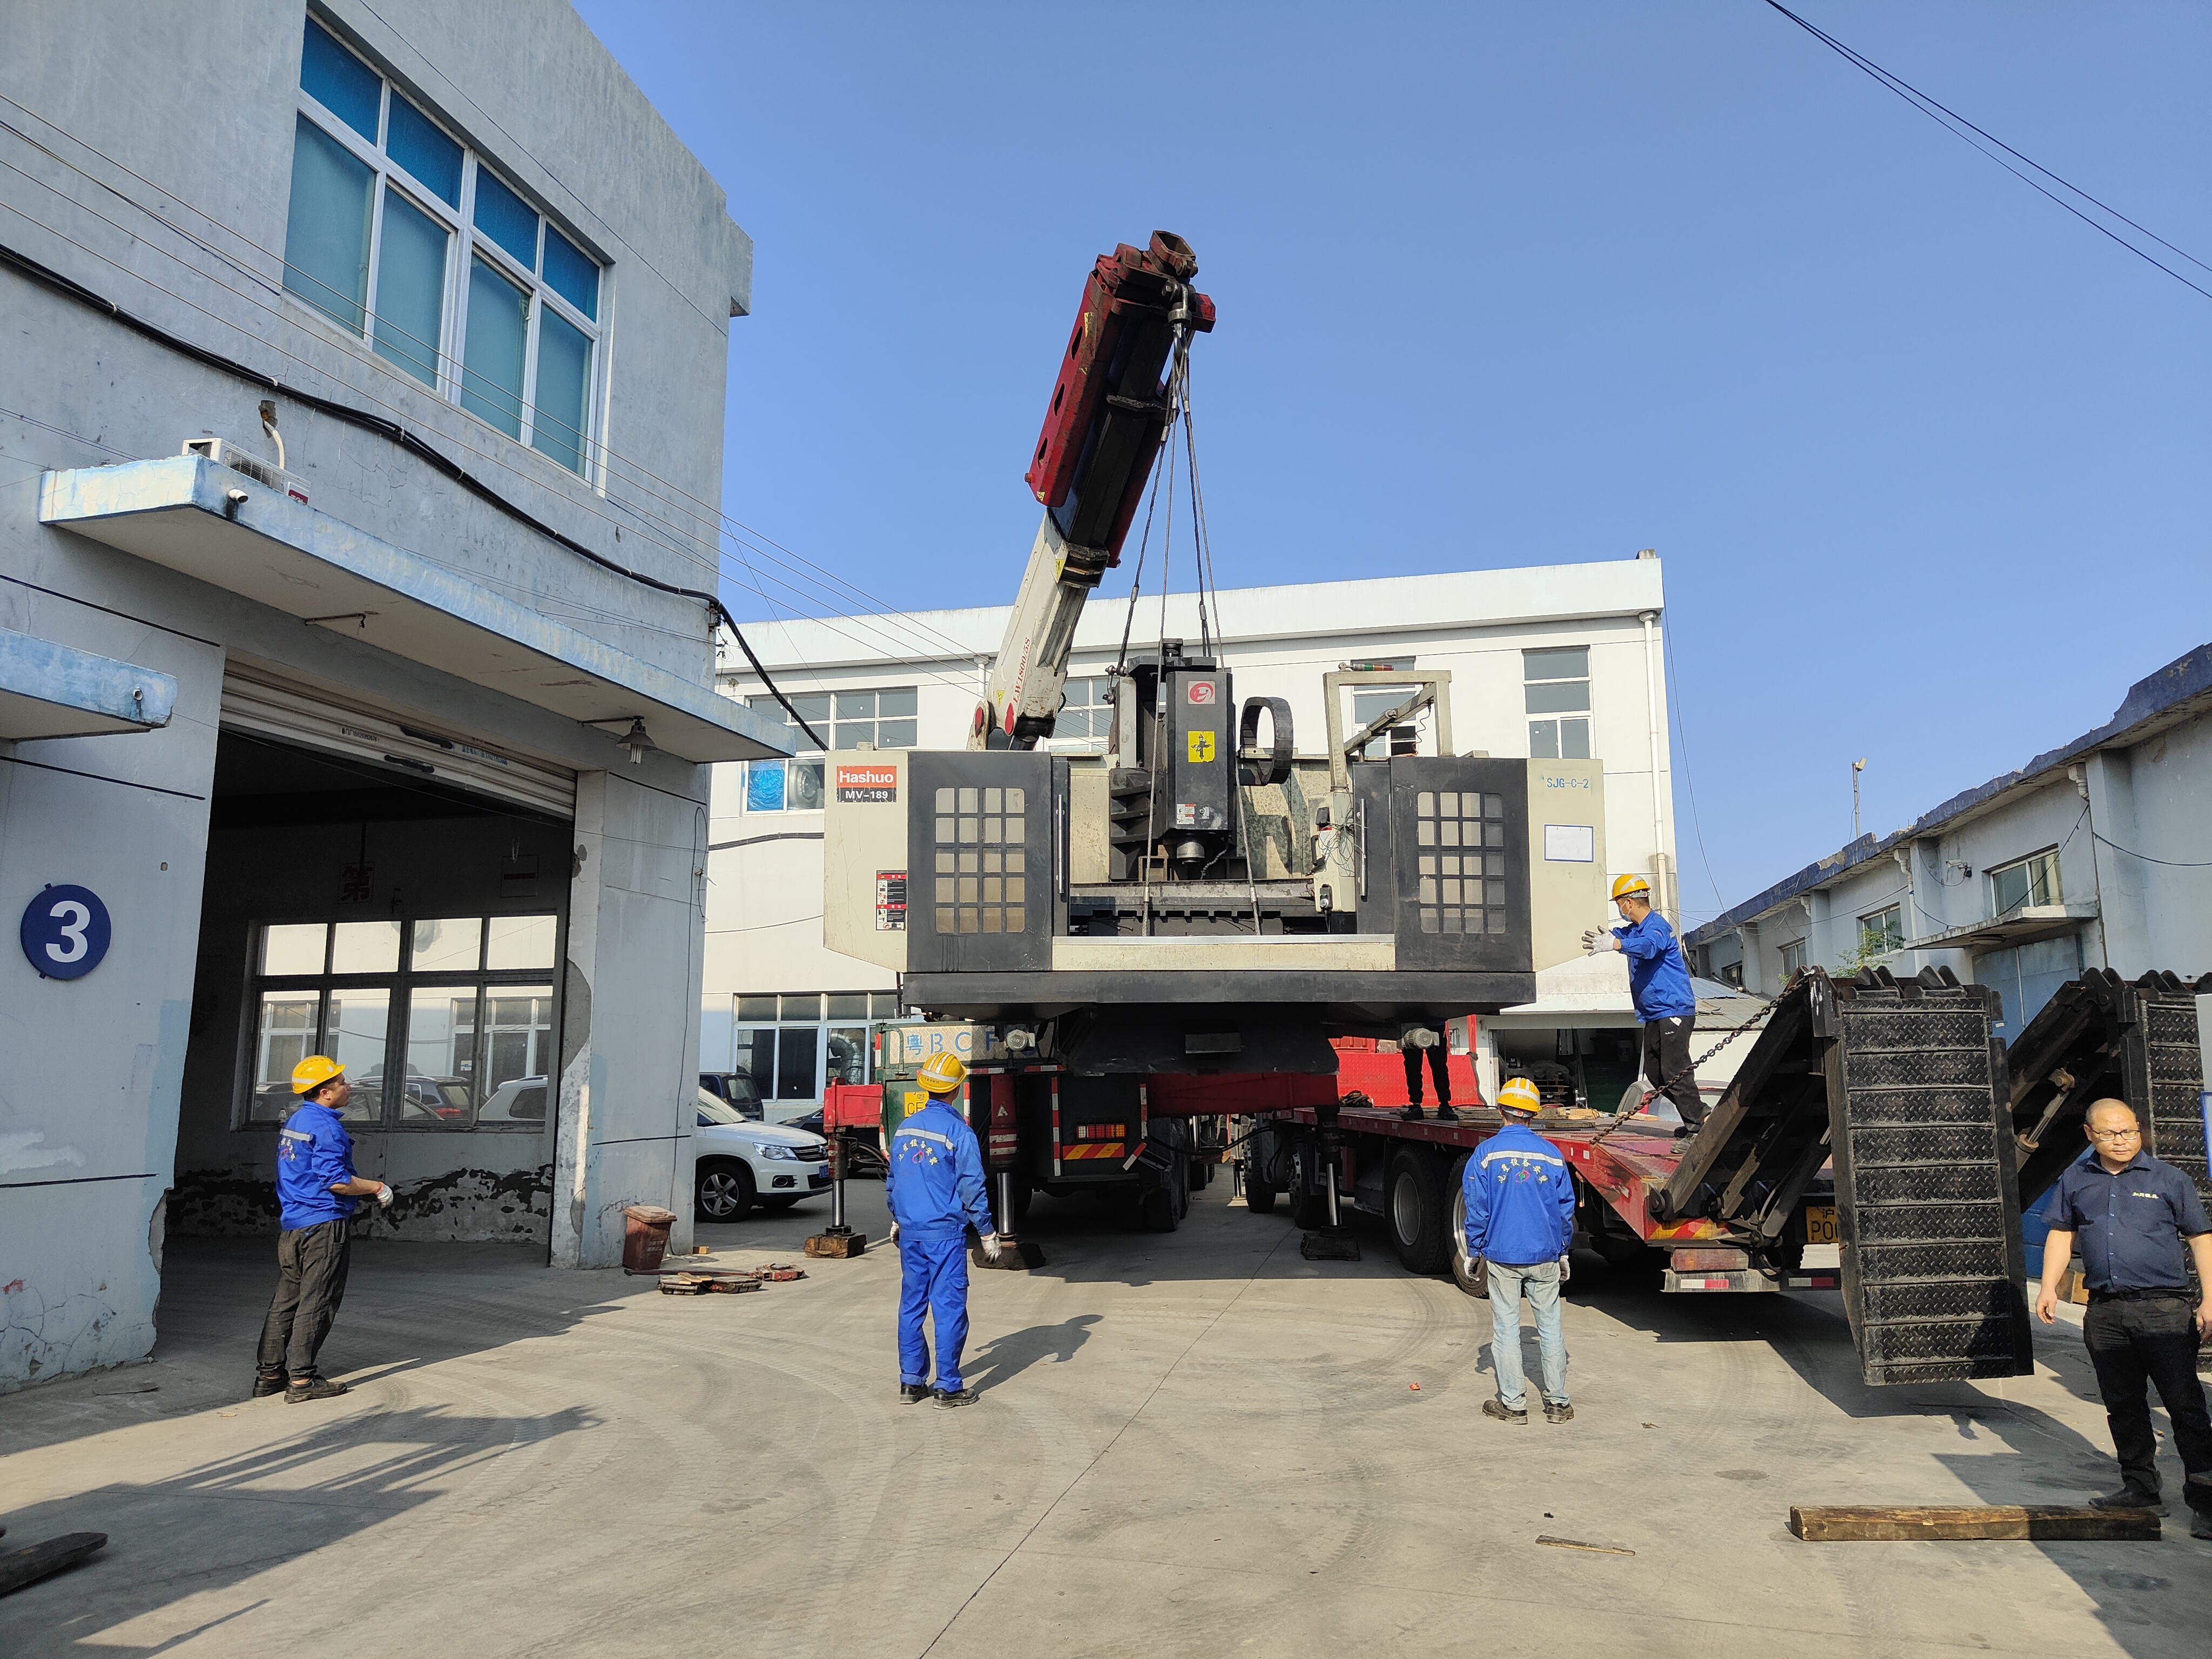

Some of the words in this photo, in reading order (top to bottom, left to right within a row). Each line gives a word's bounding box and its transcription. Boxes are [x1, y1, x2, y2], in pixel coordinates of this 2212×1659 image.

[839, 770, 894, 783] Hashuo
[1546, 777, 1589, 788] SJG-C-2
[845, 790, 888, 799] MV-189
[46, 900, 90, 963] 3
[1822, 1208, 1835, 1219] 沪
[1811, 1220, 1838, 1241] P0
